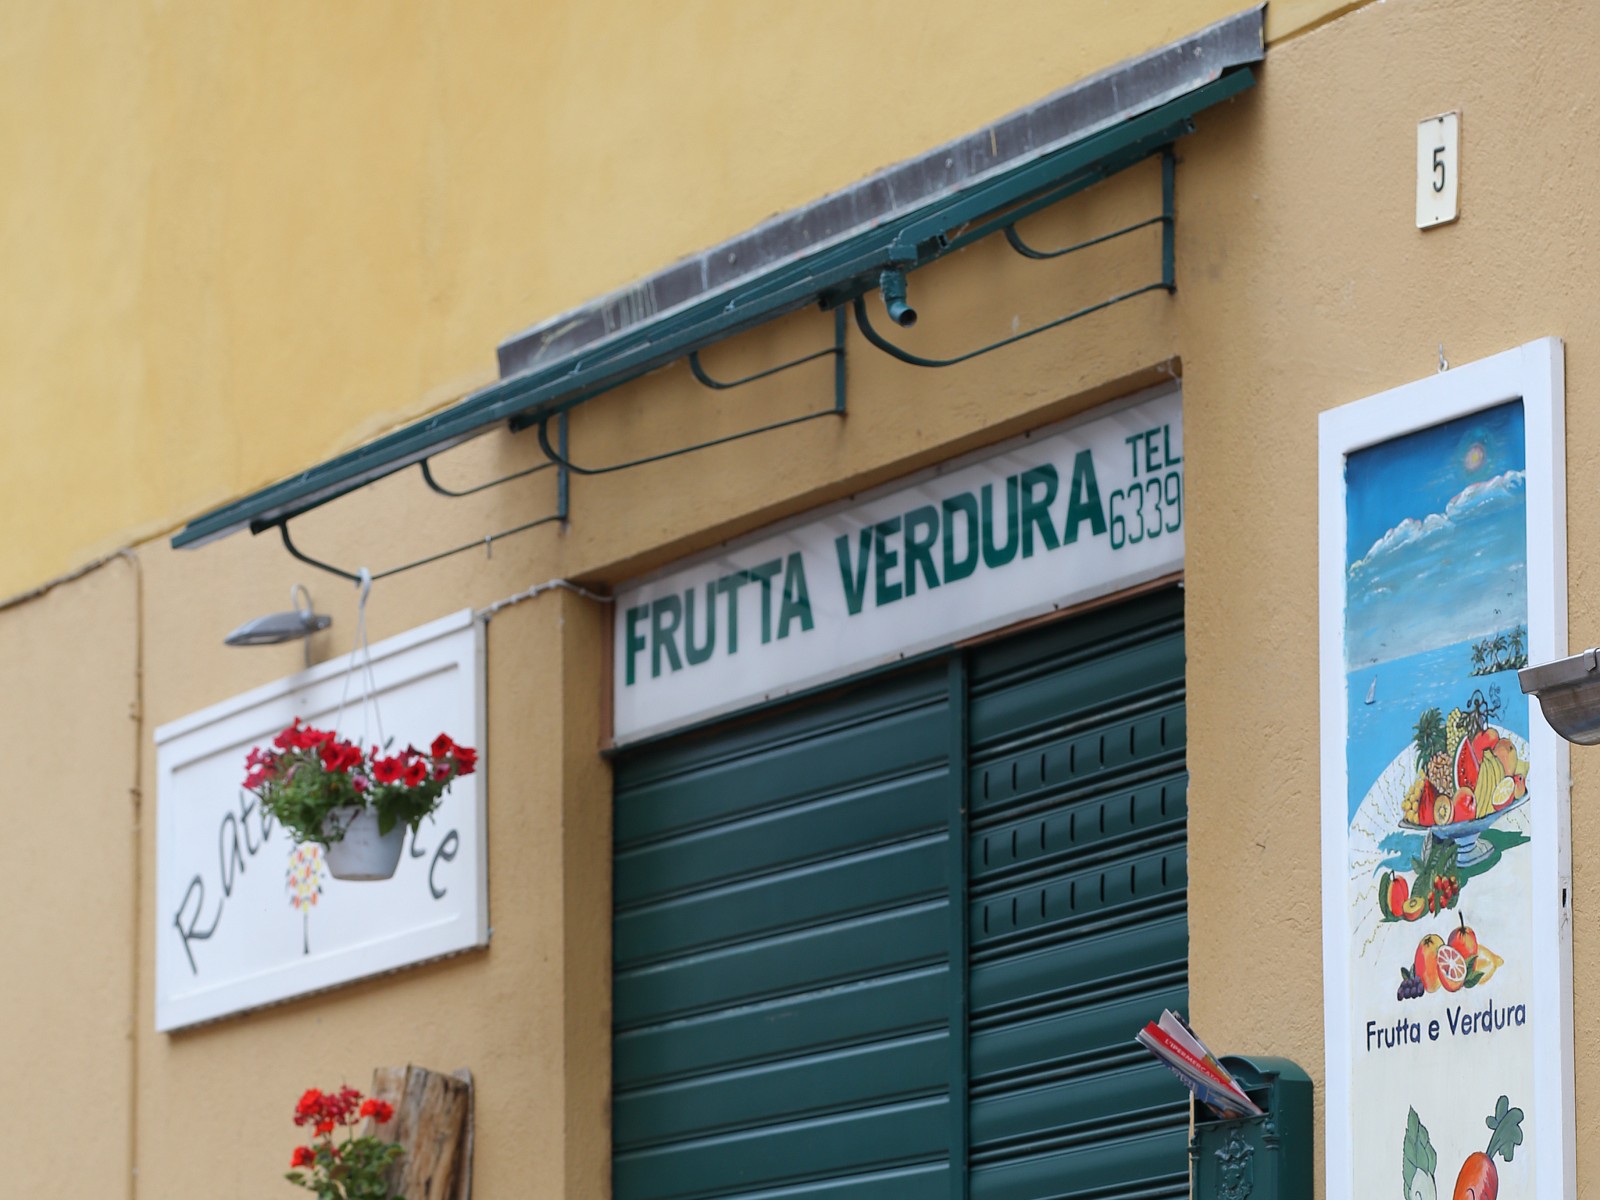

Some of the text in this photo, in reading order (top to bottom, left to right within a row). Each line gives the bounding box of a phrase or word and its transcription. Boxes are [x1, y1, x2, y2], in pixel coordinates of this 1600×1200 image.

[1432, 146, 1446, 193] 5
[1109, 471, 1184, 551] 6339
[625, 448, 1108, 686] FRUTTA VERDURA
[1366, 998, 1526, 1052] Frutta e Verdura
